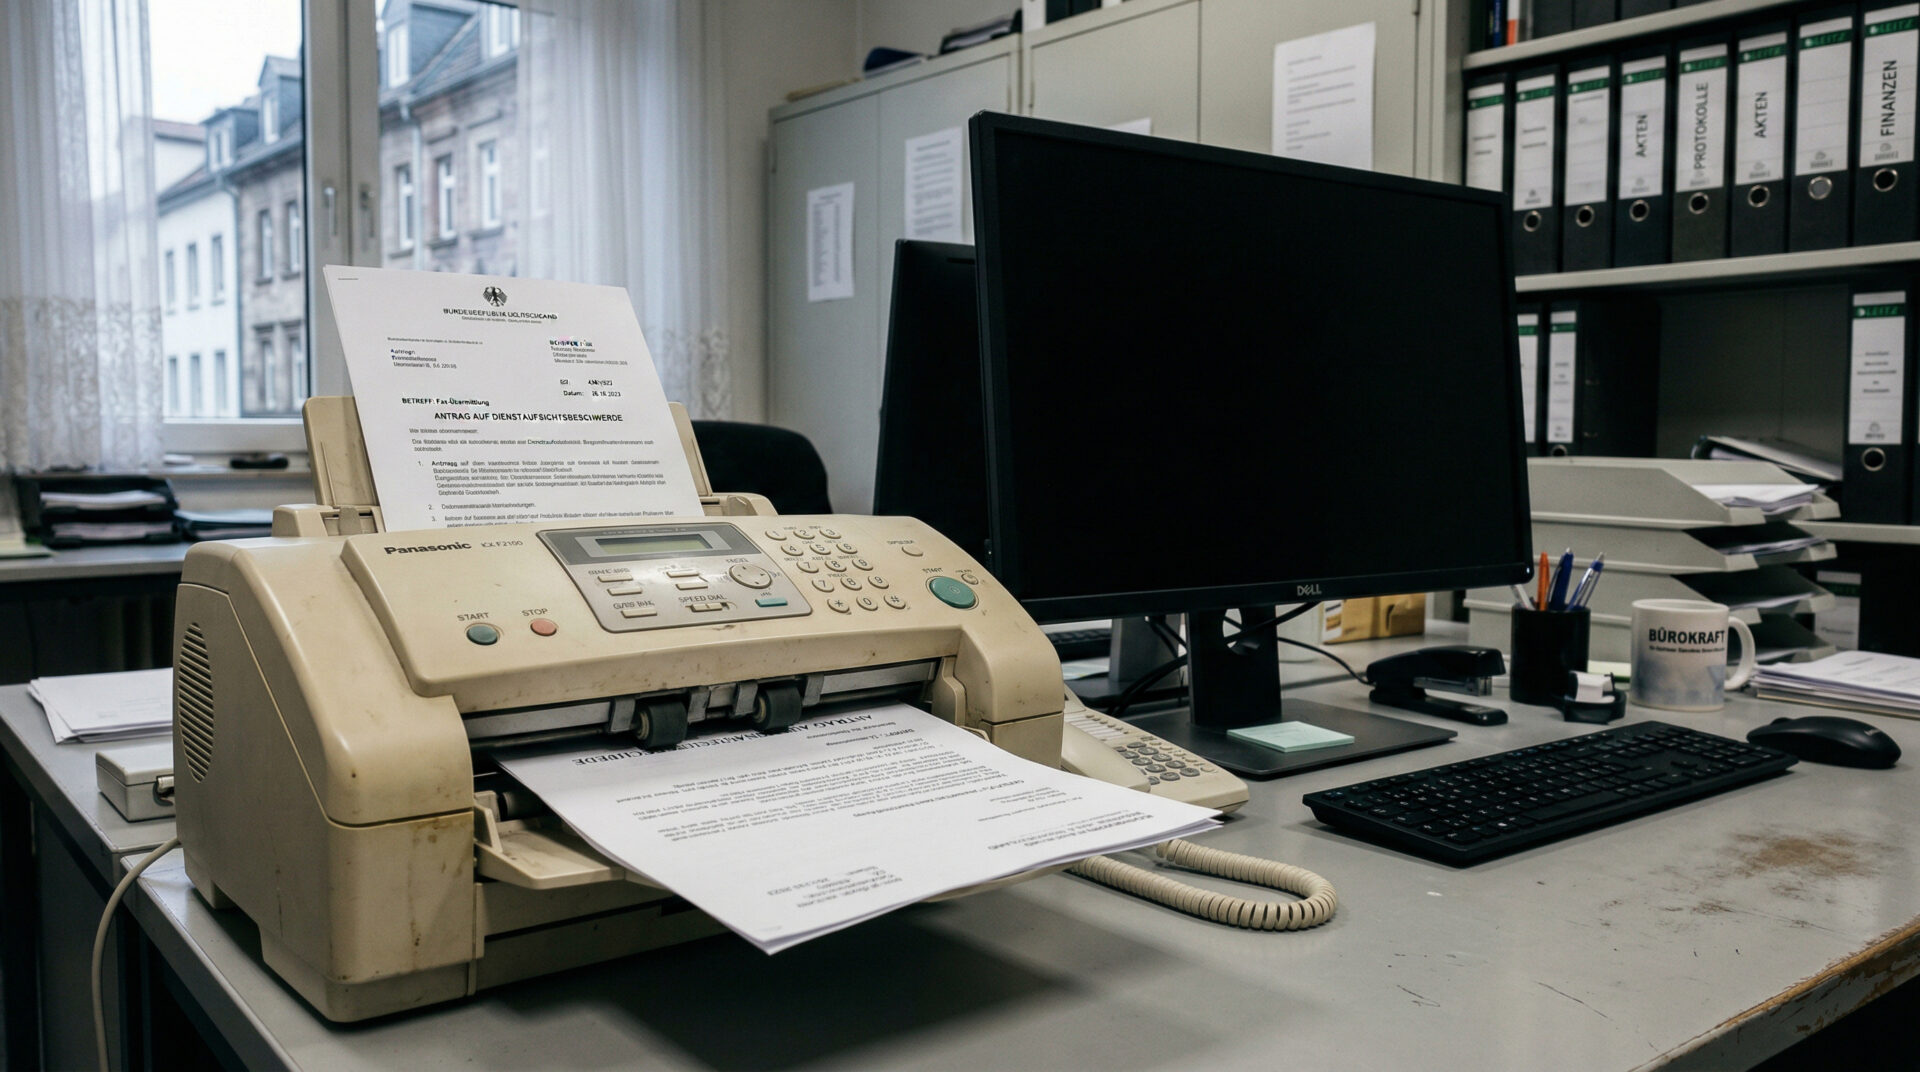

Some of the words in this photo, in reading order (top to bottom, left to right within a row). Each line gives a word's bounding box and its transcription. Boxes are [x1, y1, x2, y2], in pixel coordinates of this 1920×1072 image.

[1880, 60, 1898, 137] FINANZEN
[1754, 91, 1768, 138] AKTEN
[1693, 82, 1709, 170] PROTOKOLLE
[1635, 114, 1648, 158] AKTEN
[434, 412, 470, 421] ANTRAG
[473, 413, 490, 421] AUF
[384, 541, 473, 555] Panasonic
[803, 561, 811, 569] 7
[831, 560, 841, 568] 8
[818, 579, 826, 588] 7
[846, 578, 856, 586] 8
[874, 576, 883, 584] 9
[1296, 583, 1322, 597] DELL
[678, 595, 706, 604] SPEED
[707, 594, 728, 602] DIAL
[862, 597, 872, 606] 0
[457, 612, 490, 622] START
[521, 608, 549, 617] STOP
[1648, 626, 1725, 645] BÜROKRAFT
